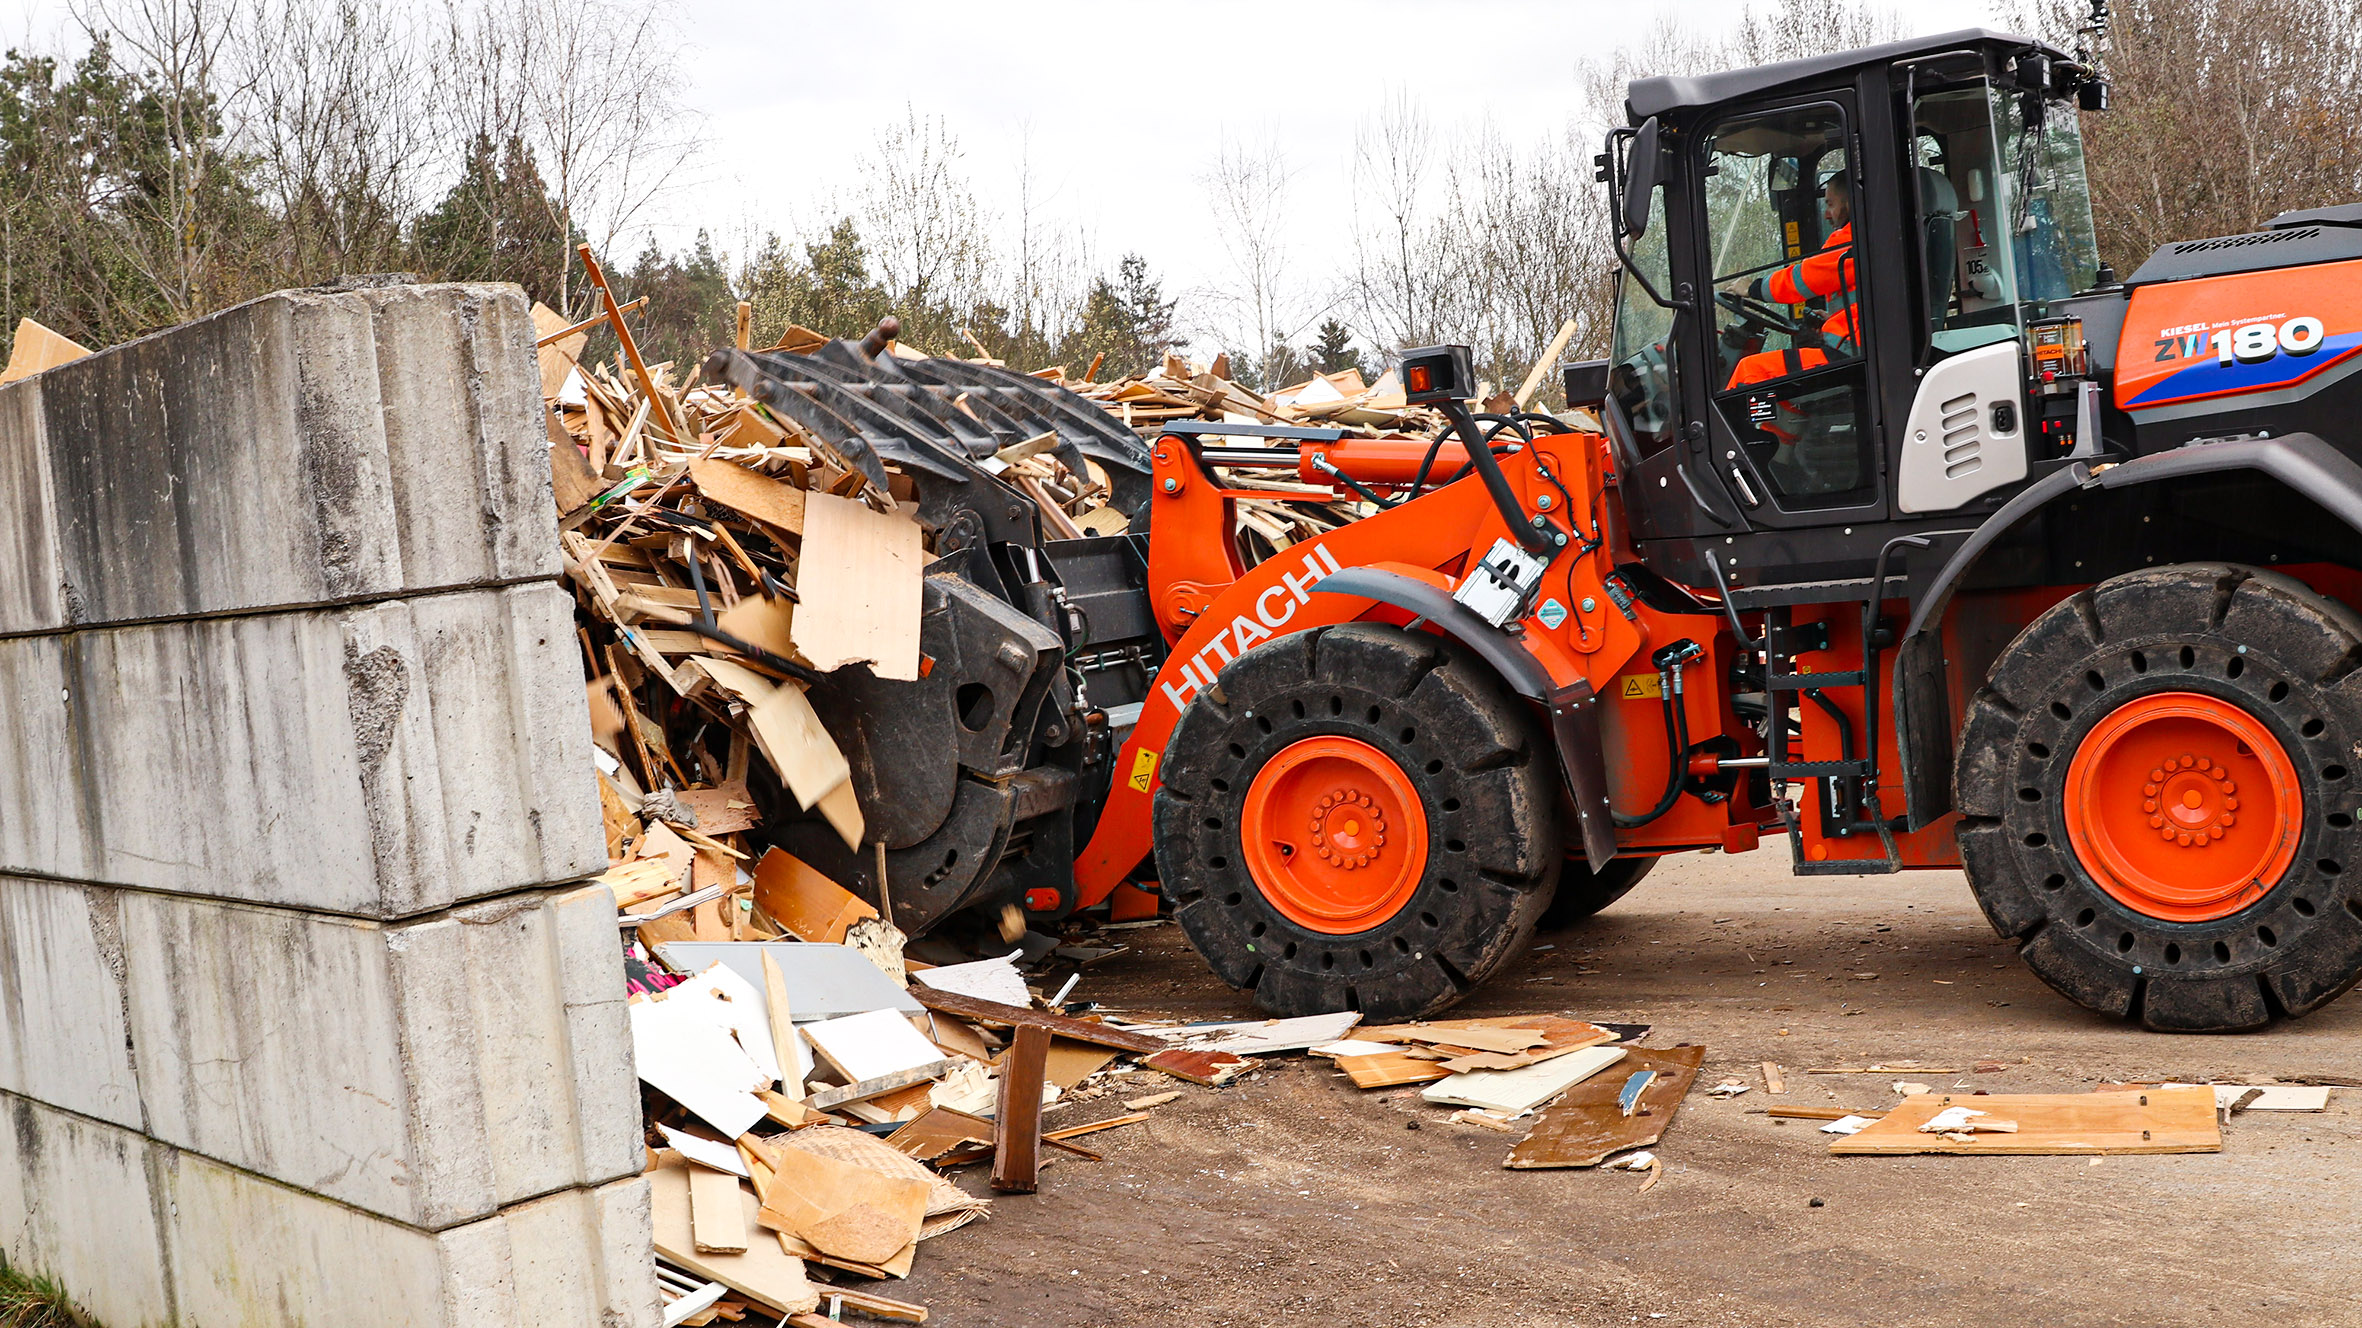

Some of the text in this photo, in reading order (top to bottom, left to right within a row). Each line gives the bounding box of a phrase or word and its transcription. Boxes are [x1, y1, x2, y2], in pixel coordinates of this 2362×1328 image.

[1966, 259, 1984, 274] 105
[2160, 312, 2287, 338] KIESEL Mein Systempartner.
[1160, 542, 1342, 715] HITACHI
